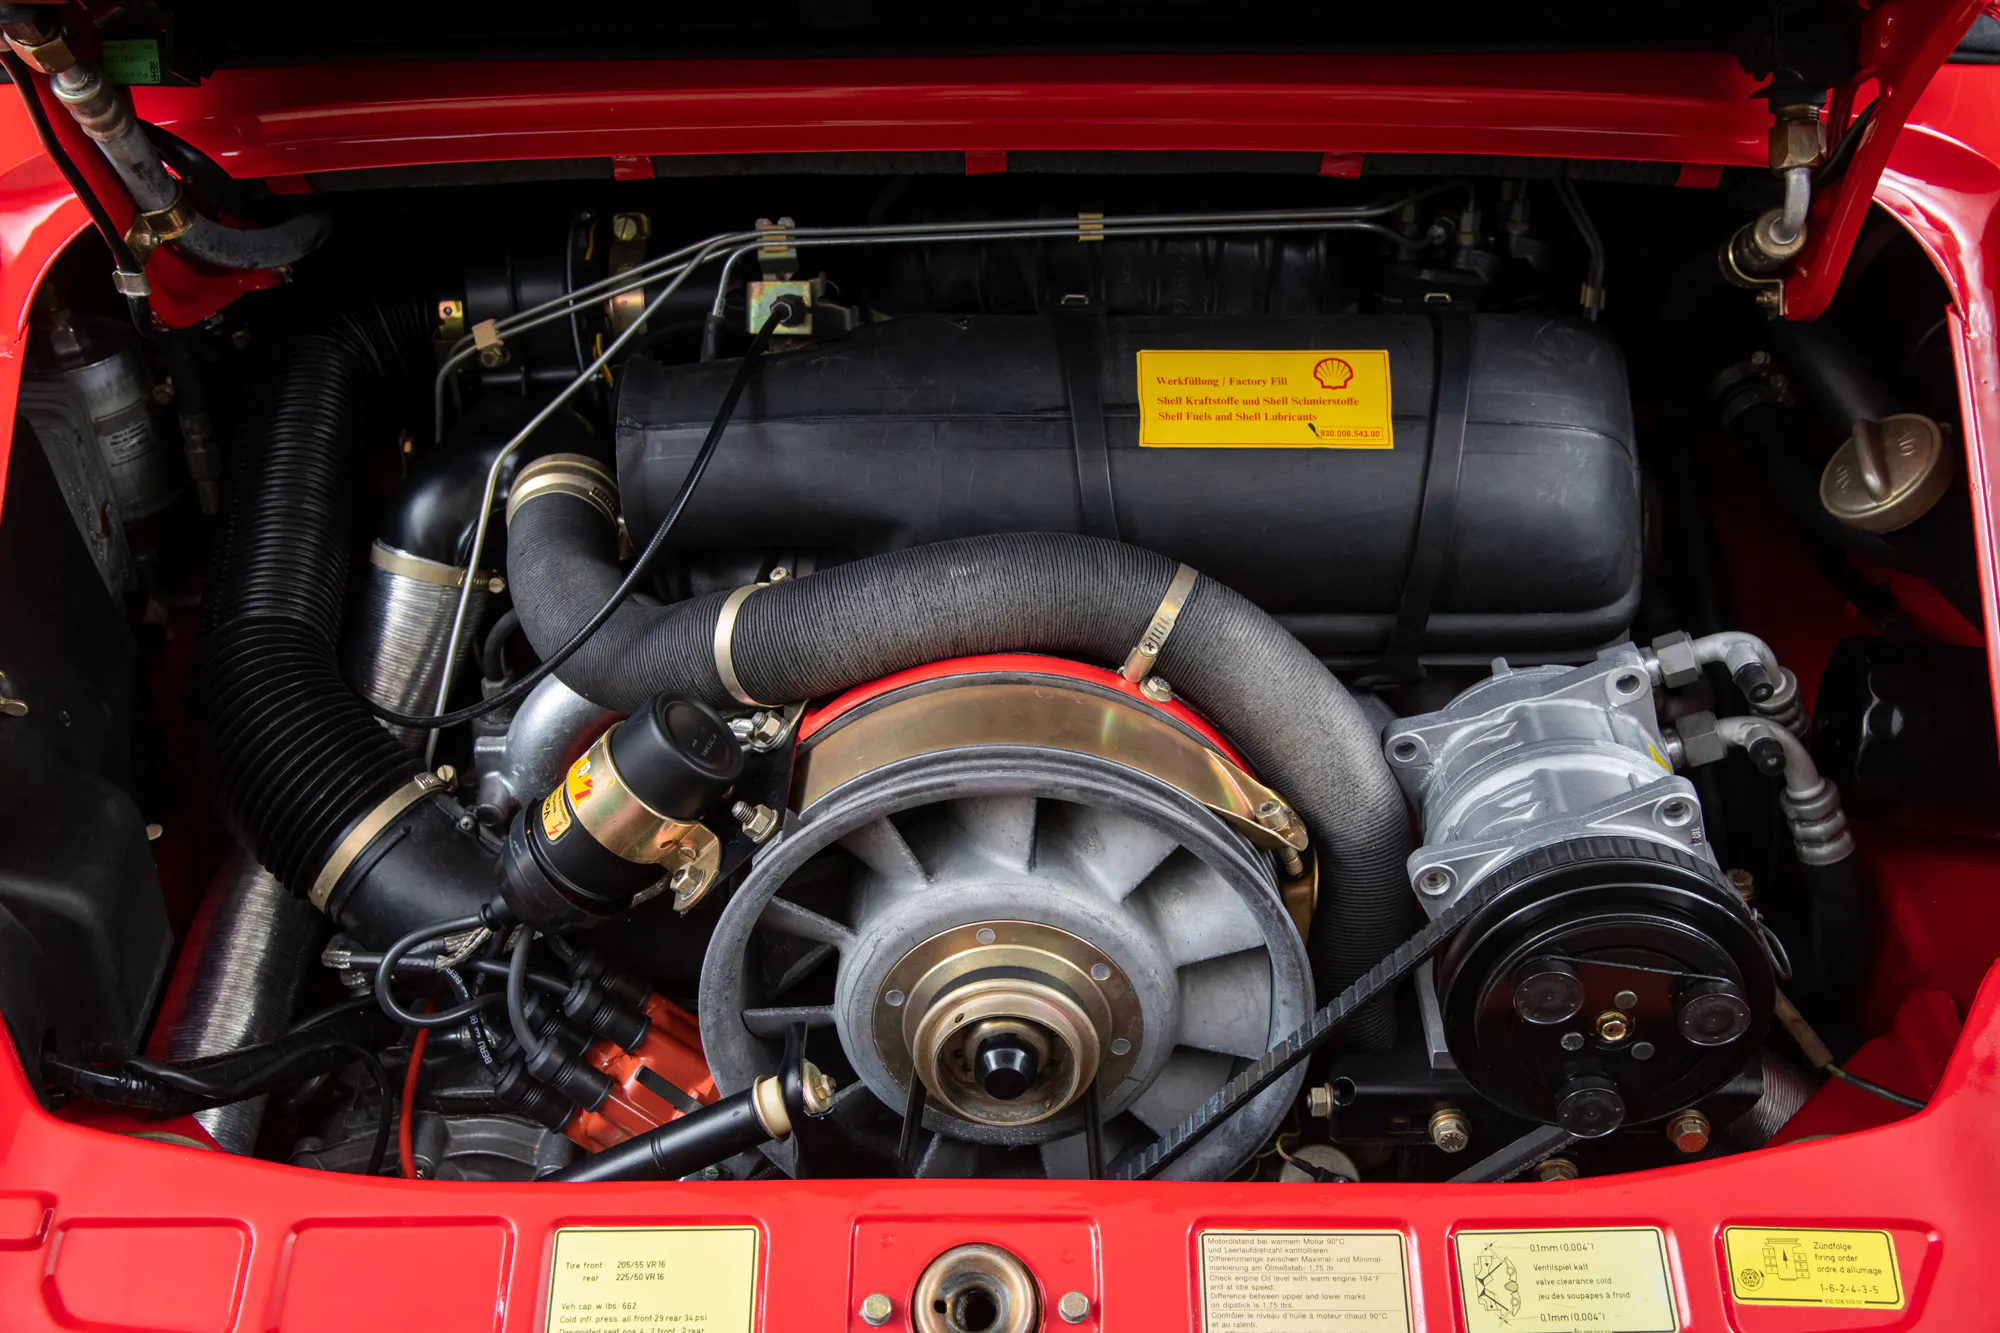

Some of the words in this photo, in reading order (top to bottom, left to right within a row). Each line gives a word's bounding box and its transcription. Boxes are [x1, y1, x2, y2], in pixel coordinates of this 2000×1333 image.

[1156, 376, 1219, 386] Werkfüllung
[1222, 376, 1226, 386] /
[1229, 377, 1267, 387] Factory
[1271, 378, 1287, 386] Fill
[1157, 396, 1182, 406] Shell
[1186, 396, 1239, 406] Kraftstoffe
[1242, 397, 1260, 406] und
[1263, 396, 1288, 406] Shell
[1291, 396, 1359, 406] Schmierstoffe
[1158, 412, 1182, 420] Shell
[1186, 412, 1212, 421] Fuels
[1215, 412, 1232, 421] and
[1236, 412, 1260, 421] Shell
[1264, 412, 1317, 422] Lubricants
[1320, 430, 1380, 438] 930.006.543.00
[477, 1041, 493, 1065] BERU
[1813, 1241, 1851, 1252] Zündfolge
[1815, 1254, 1835, 1263] firing
[616, 1273, 643, 1281] 225/50
[1235, 1275, 1258, 1283] engine
[1333, 1275, 1356, 1283] engine
[1820, 1284, 1879, 1294] 1-6-2-4-3-5
[1538, 1293, 1550, 1301] jeu
[1613, 1291, 1630, 1299] froid
[695, 1314, 707, 1323] psi
